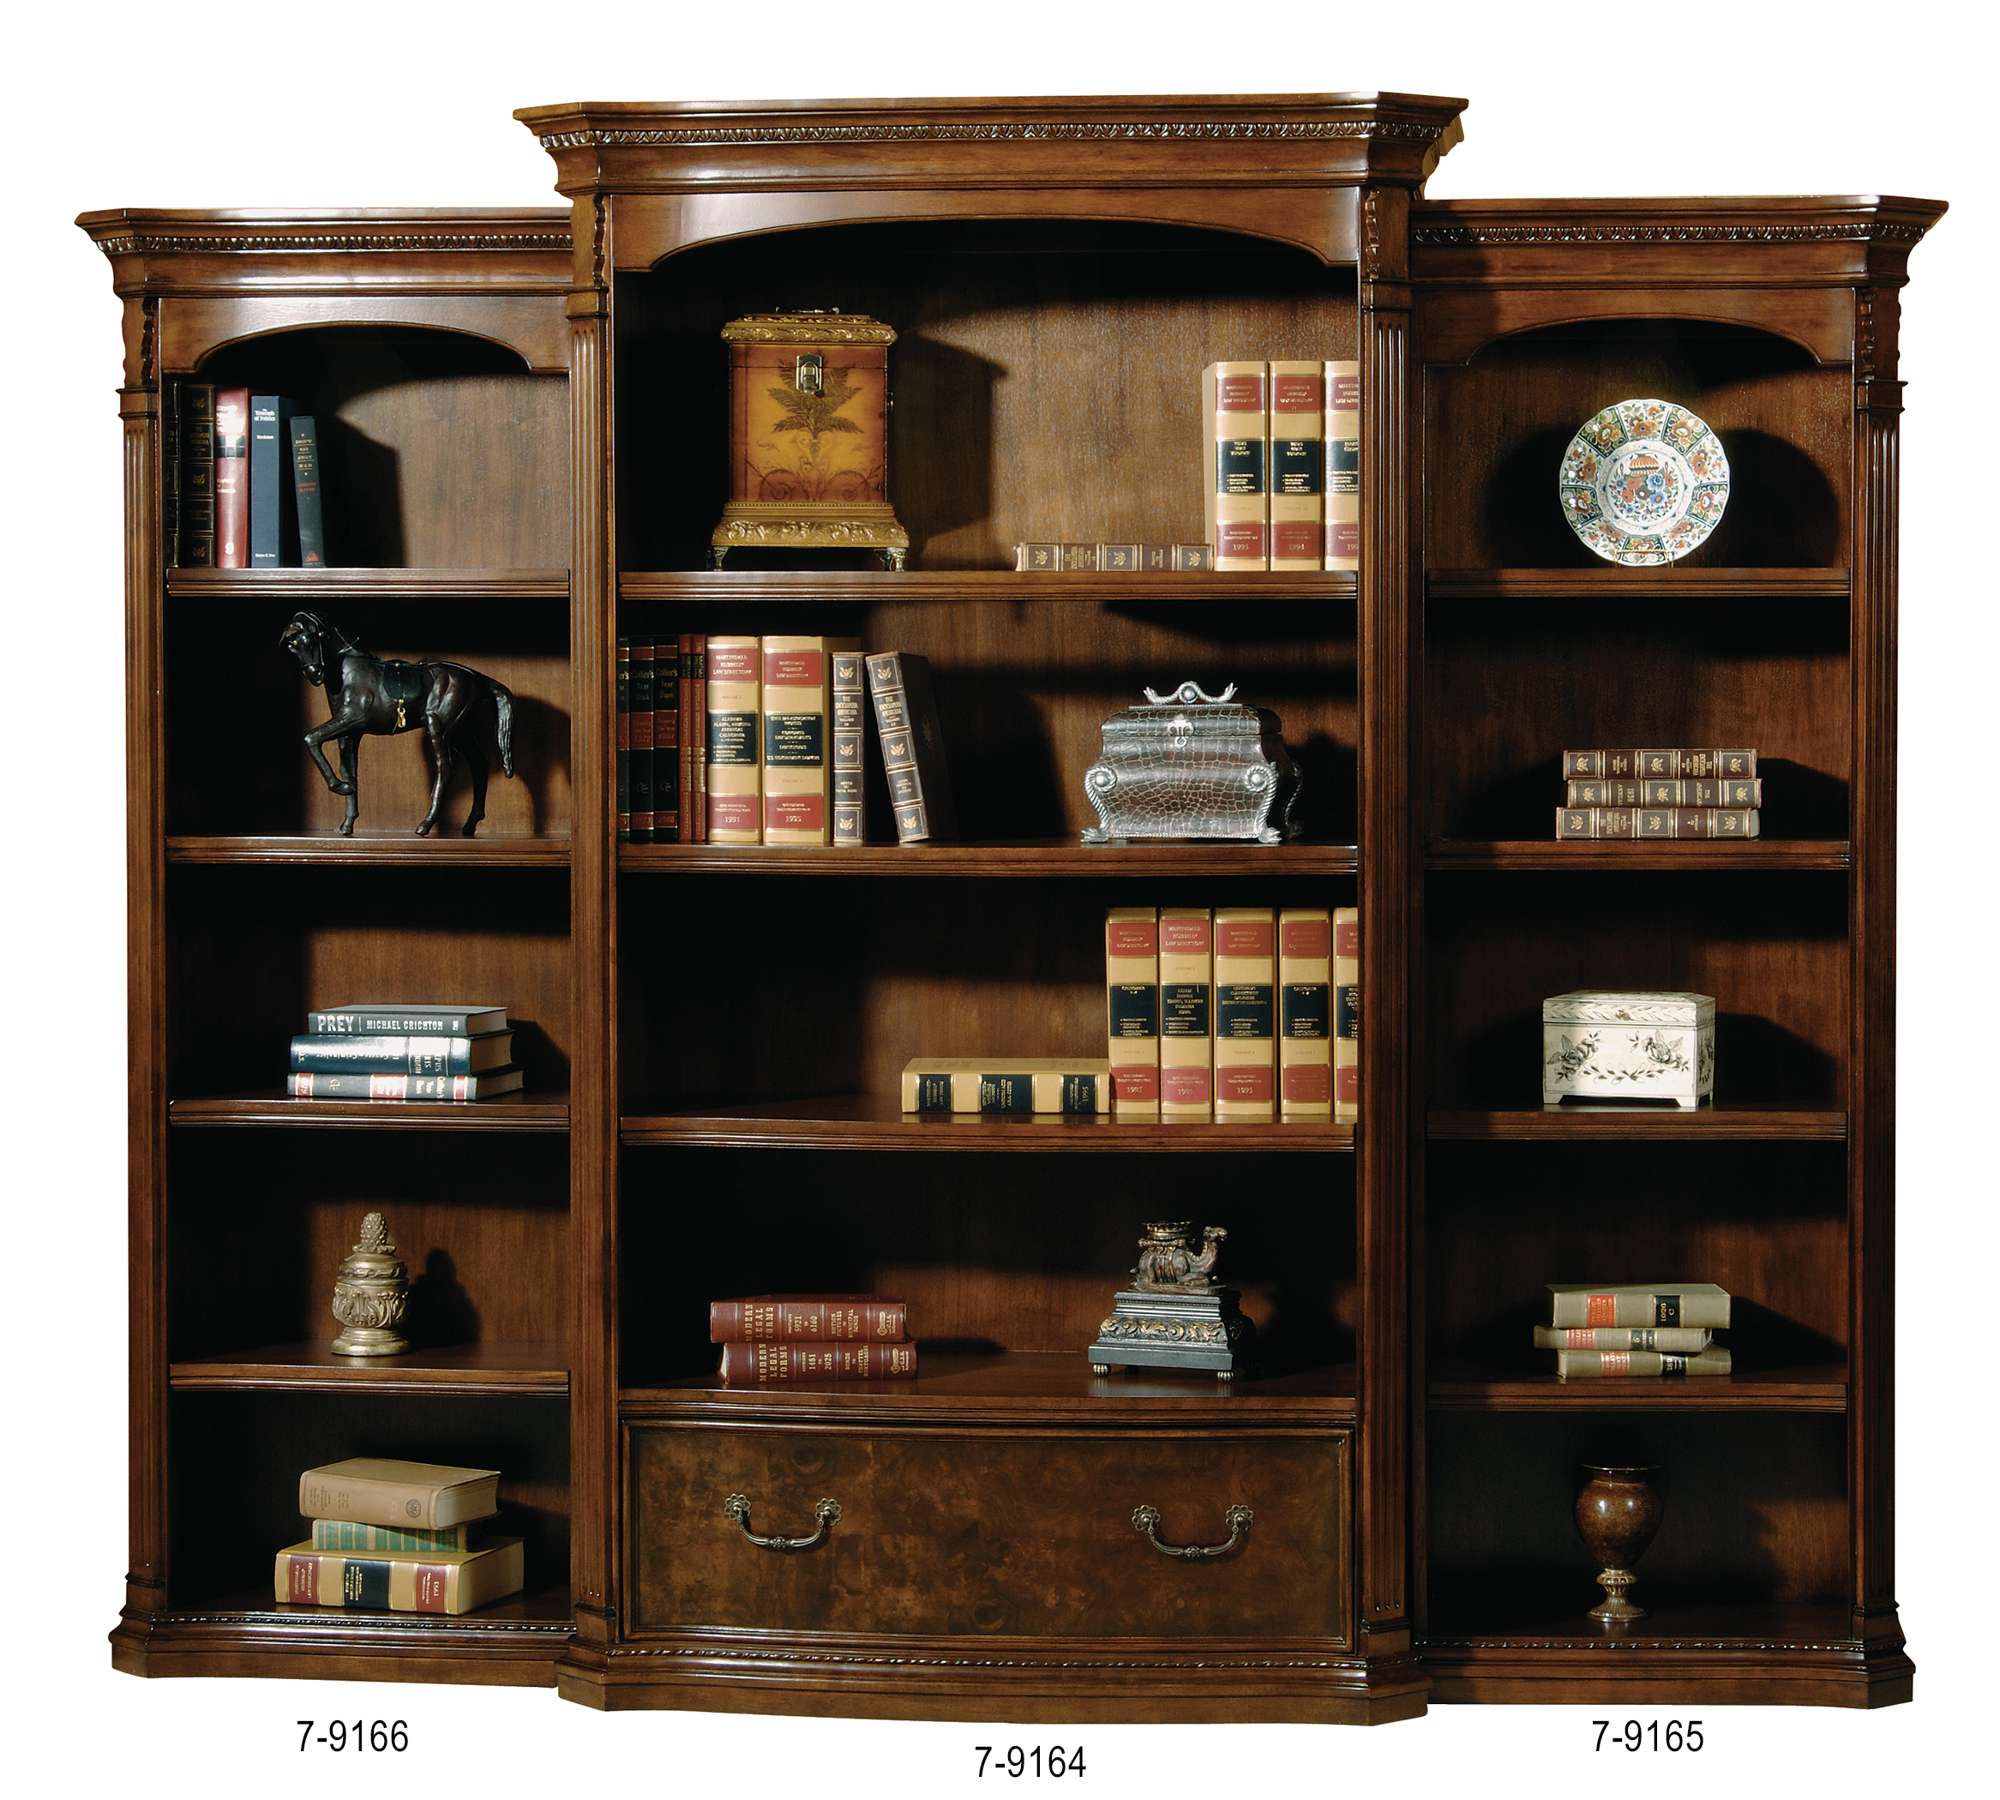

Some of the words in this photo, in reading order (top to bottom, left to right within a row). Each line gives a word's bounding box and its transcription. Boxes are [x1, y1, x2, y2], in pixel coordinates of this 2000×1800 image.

[317, 1015, 355, 1032] PREY
[366, 1020, 401, 1030] MICHAEL
[403, 1020, 444, 1031] CRICHTON
[745, 1304, 753, 1342] MODERN
[755, 1308, 763, 1338] LEGAL
[766, 1307, 774, 1339] FORMS
[759, 1344, 767, 1382] MODERN
[769, 1347, 777, 1377] LEGAL
[779, 1346, 787, 1378] FORMS
